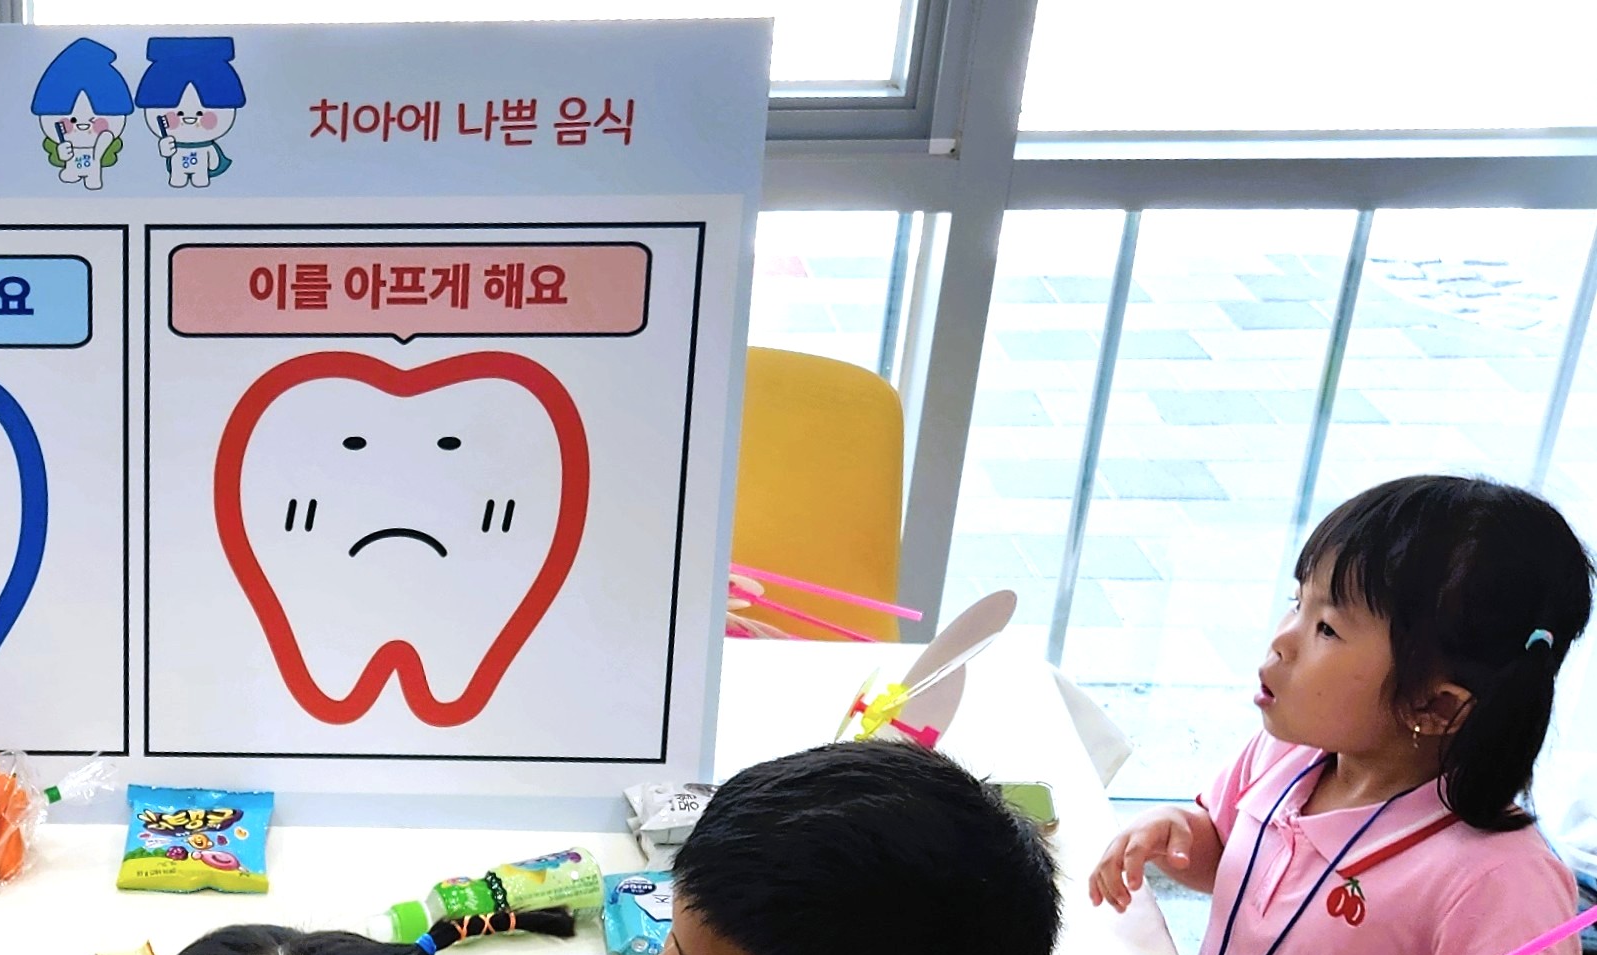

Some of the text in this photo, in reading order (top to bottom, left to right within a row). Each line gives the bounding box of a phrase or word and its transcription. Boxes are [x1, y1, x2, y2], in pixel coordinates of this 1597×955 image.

[309, 97, 636, 147] 치아에 나쁜 음식
[249, 262, 569, 312] 이를 아프게 해요
